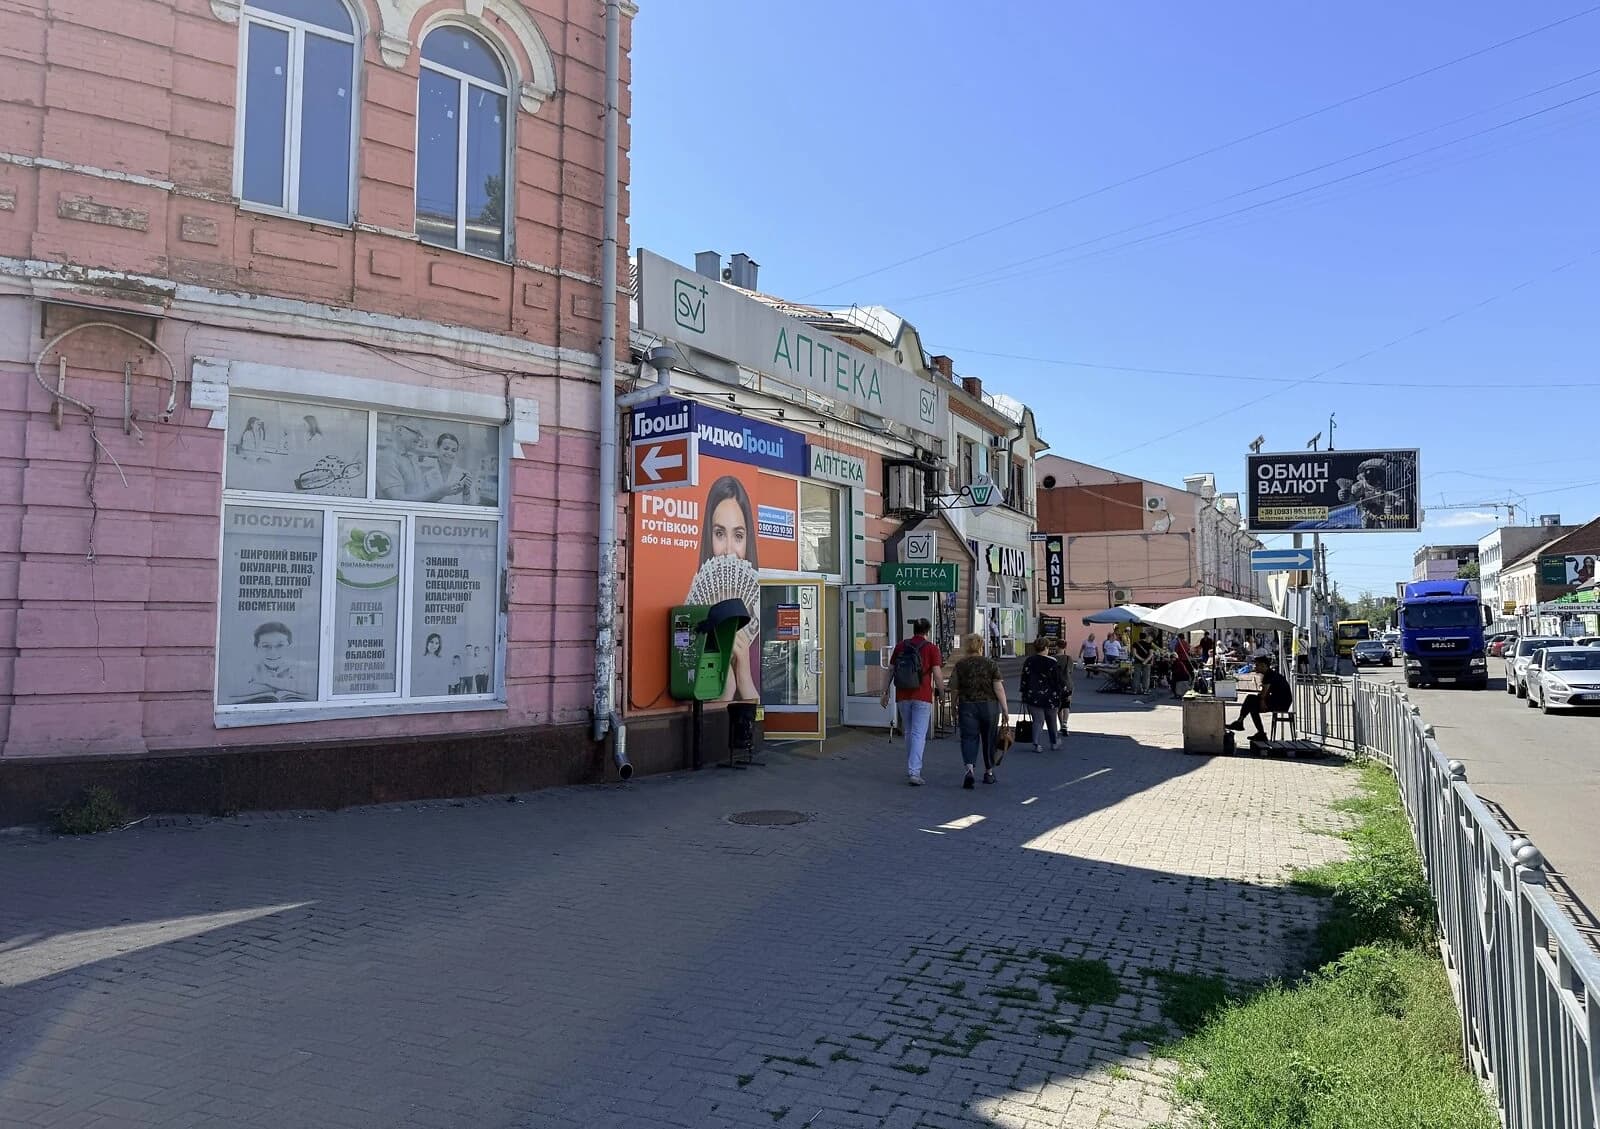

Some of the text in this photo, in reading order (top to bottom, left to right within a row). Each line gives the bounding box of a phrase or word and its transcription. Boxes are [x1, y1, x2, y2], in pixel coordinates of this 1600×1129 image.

[773, 326, 883, 404] АПТЕКА
[634, 404, 689, 437] Гроші
[814, 452, 864, 482] АПТЕКА
[1257, 462, 1329, 479] ОБМІН
[1258, 479, 1329, 494] ВАЛЮТ
[641, 494, 699, 520] ГРОШІ
[234, 513, 314, 529] ПОСЛУГИ
[641, 518, 699, 535] готівкою
[421, 525, 489, 539] ПОСЛУГИ
[641, 534, 699, 550] або на карту
[240, 549, 318, 562] ШИРОКИЙ ВИБІР
[426, 556, 459, 567] ЗНАННЯ
[240, 562, 315, 575] ОКУЛЯРІВ, ЛІНЗ,
[426, 568, 470, 579] ТА ДОСВІД
[895, 567, 947, 579] АПТЕКА
[239, 575, 312, 587] ОПРАВ, ЕЛІТНОЇ
[1050, 553, 1061, 598] ANDI
[425, 580, 481, 591] СПЕЦІАЛІСТІВ
[238, 587, 304, 599] ЛІКУВАЛЬНОЇ
[425, 590, 473, 602] КЛАСИЧНОЇ
[238, 600, 296, 612] КОСМЕТИКИ
[350, 602, 383, 612] АПТЕКА
[424, 602, 465, 613] АПТЕЧНОЇ
[424, 615, 457, 625] СПРАВИ
[347, 638, 384, 648] УЧАСНИК
[345, 649, 386, 660] ОБЛАСНОЇ
[344, 661, 385, 672] ПРОГРАМИ
